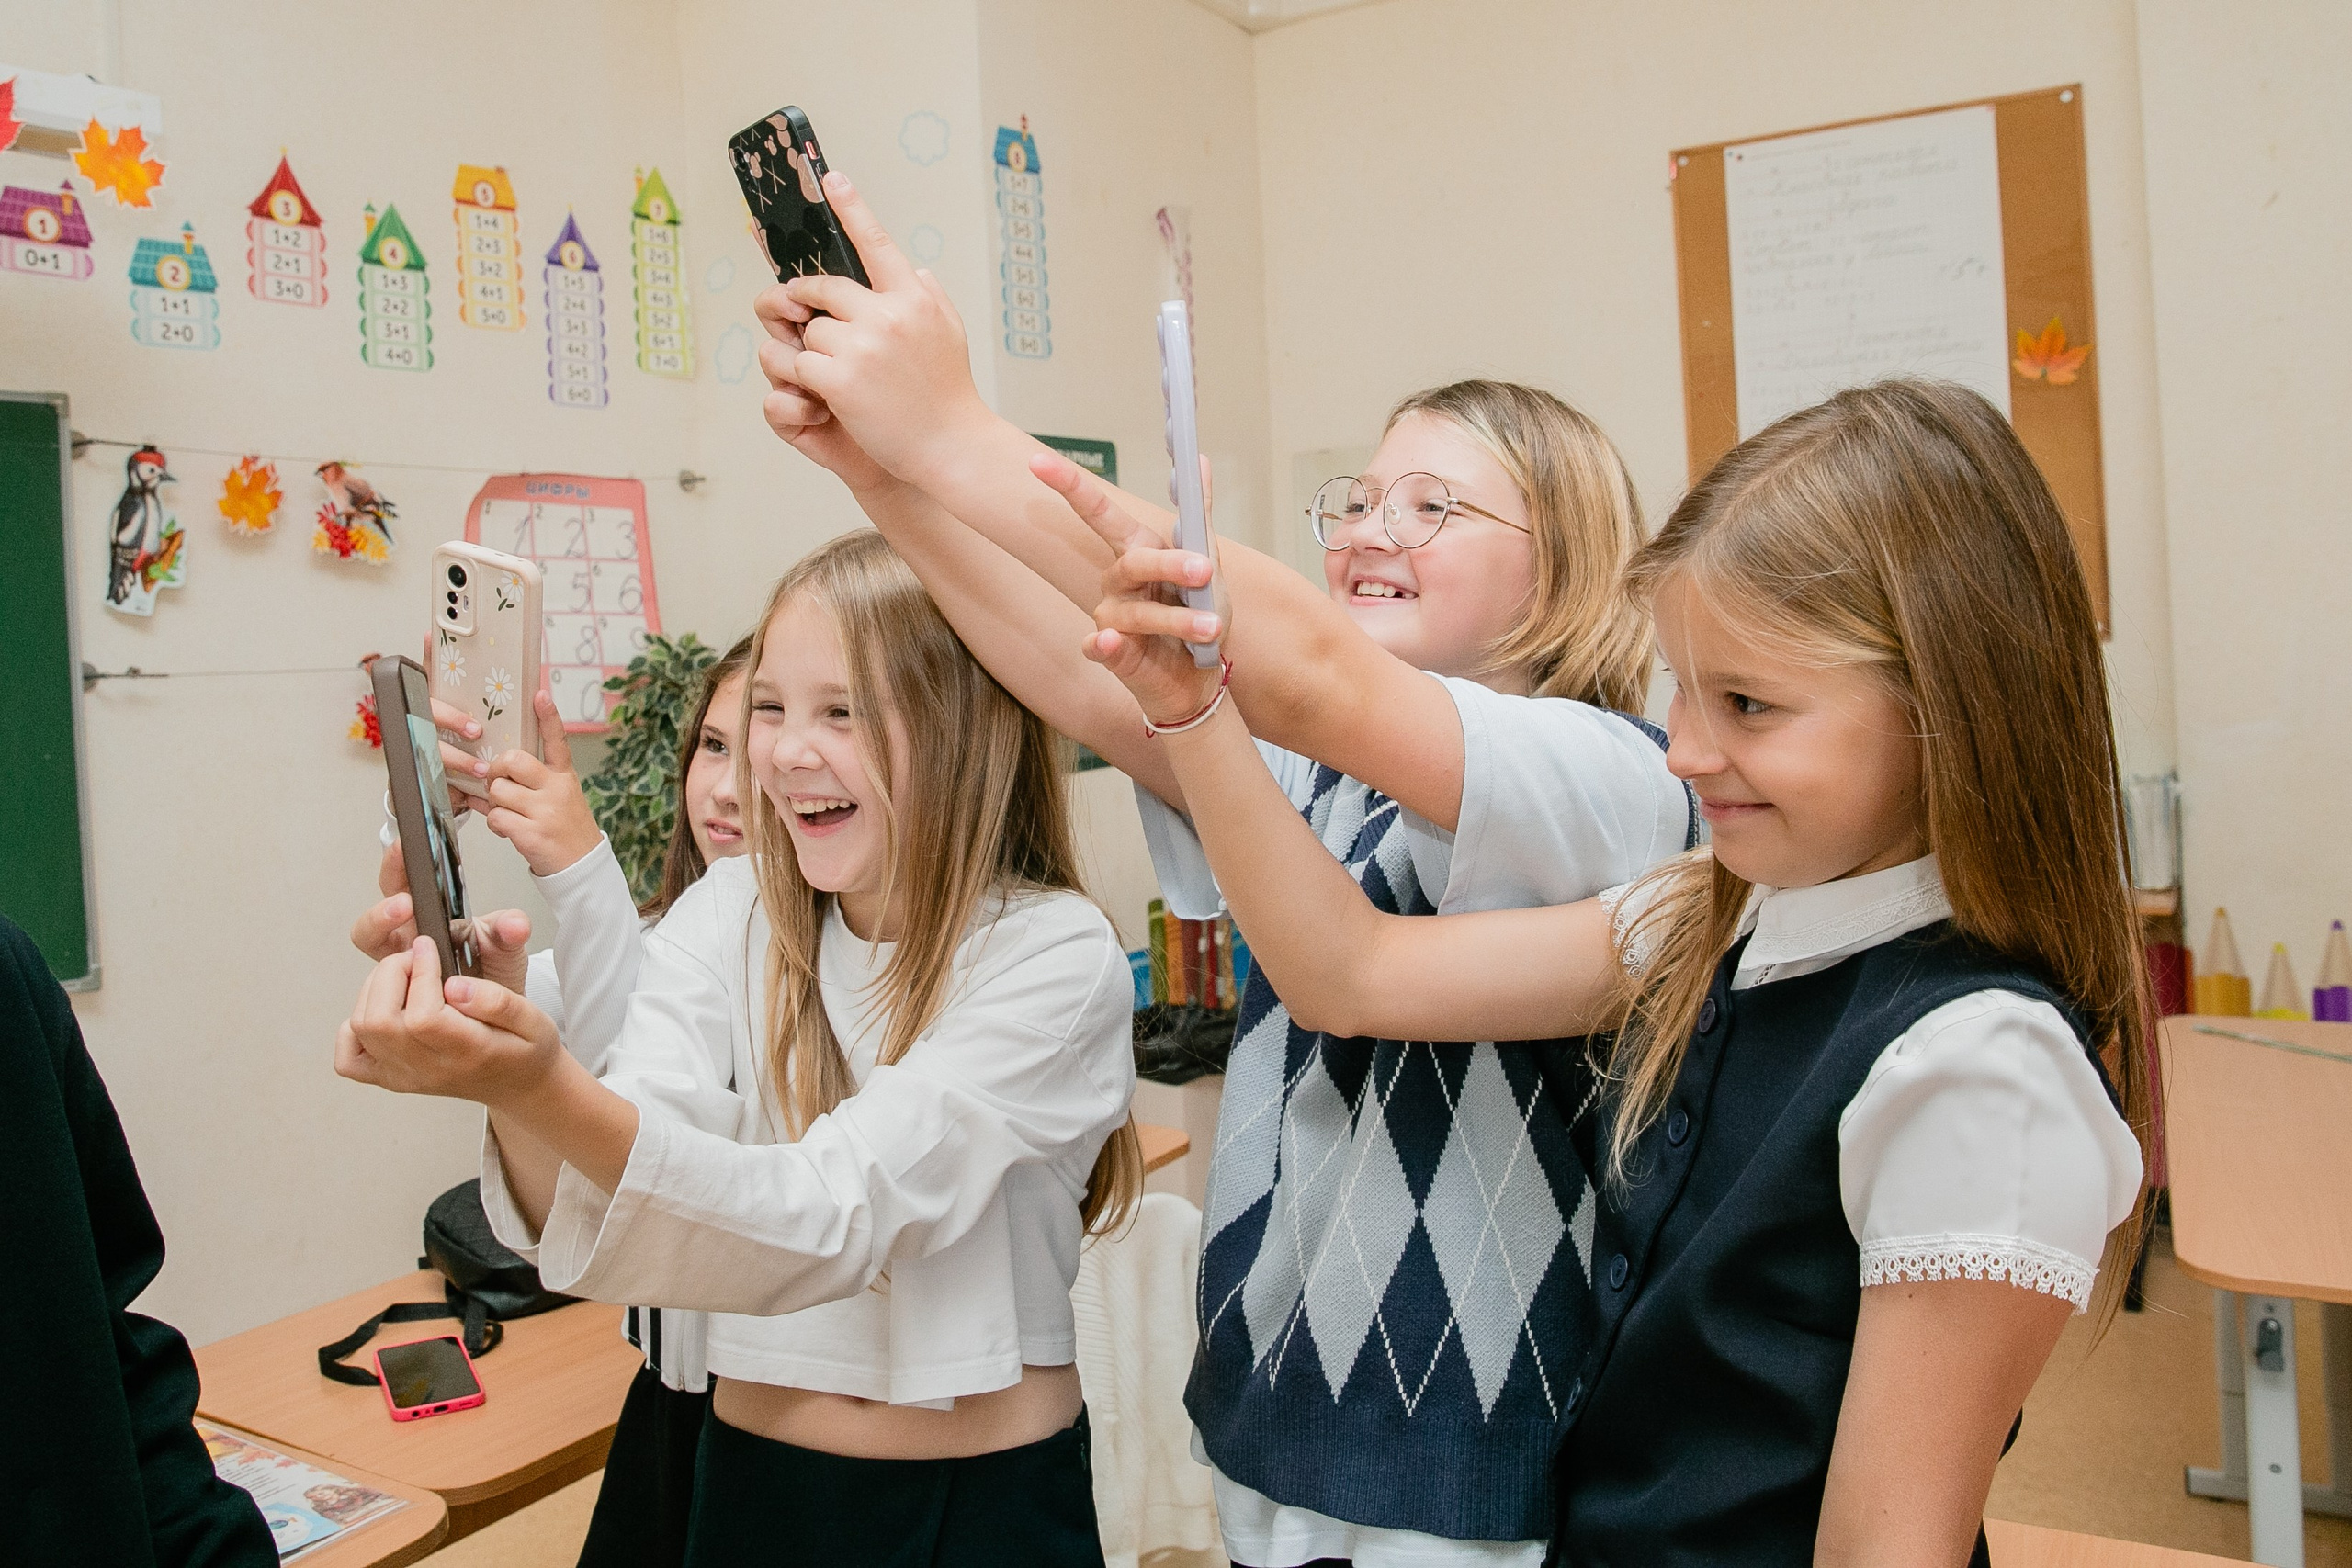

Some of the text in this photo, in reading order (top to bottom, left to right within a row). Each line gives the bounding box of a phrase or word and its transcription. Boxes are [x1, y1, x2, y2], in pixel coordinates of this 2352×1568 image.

[283, 201, 291, 217] 3
[39, 219, 47, 234] 1
[475, 215, 499, 230] 1+4
[273, 230, 301, 249] 1+2
[25, 249, 60, 270] 0+1
[390, 248, 398, 260] 4
[273, 254, 300, 273] 2+1
[170, 266, 180, 282] 2
[382, 275, 409, 291] 1+3
[276, 280, 304, 299] 3+0
[480, 285, 503, 301] 4+1
[162, 297, 190, 315] 1+1
[382, 298, 409, 316] 2+2
[161, 323, 194, 342] 2+0
[385, 322, 410, 340] 3+1
[385, 348, 413, 365] 4+0
[514, 515, 638, 560] 1 2 3
[568, 572, 642, 613] 5 6
[575, 626, 597, 665] 8
[552, 671, 561, 683] 0
[580, 680, 603, 722] 0
